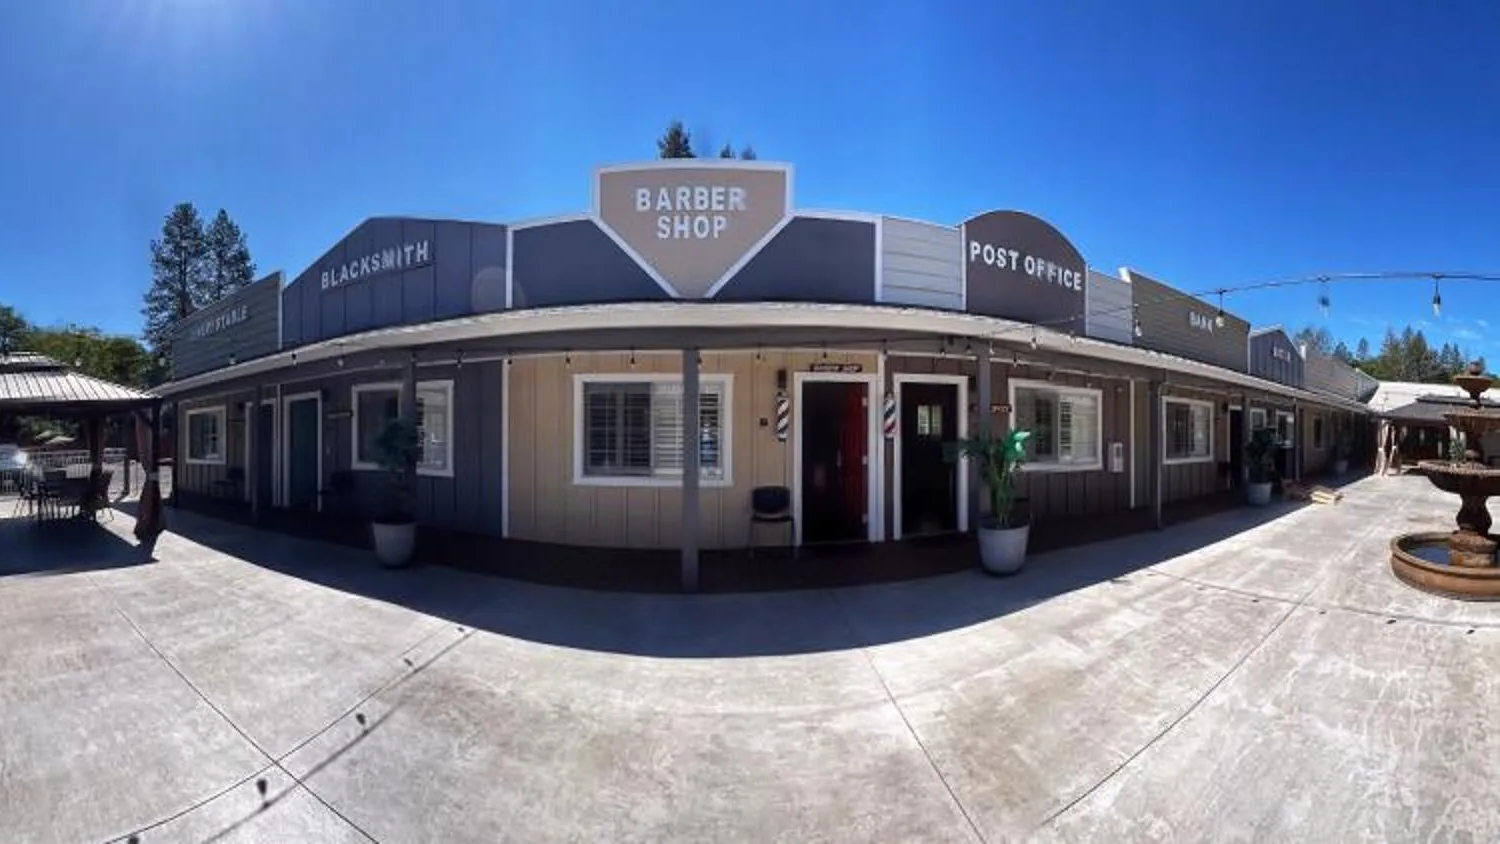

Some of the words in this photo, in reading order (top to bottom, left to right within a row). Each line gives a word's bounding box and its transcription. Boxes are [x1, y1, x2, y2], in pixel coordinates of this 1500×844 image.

[636, 186, 746, 211] BARBER
[657, 215, 727, 239] SHOP
[321, 240, 428, 290] BLACKSMITH
[969, 240, 1019, 270] POST
[1024, 255, 1082, 291] OFFICE
